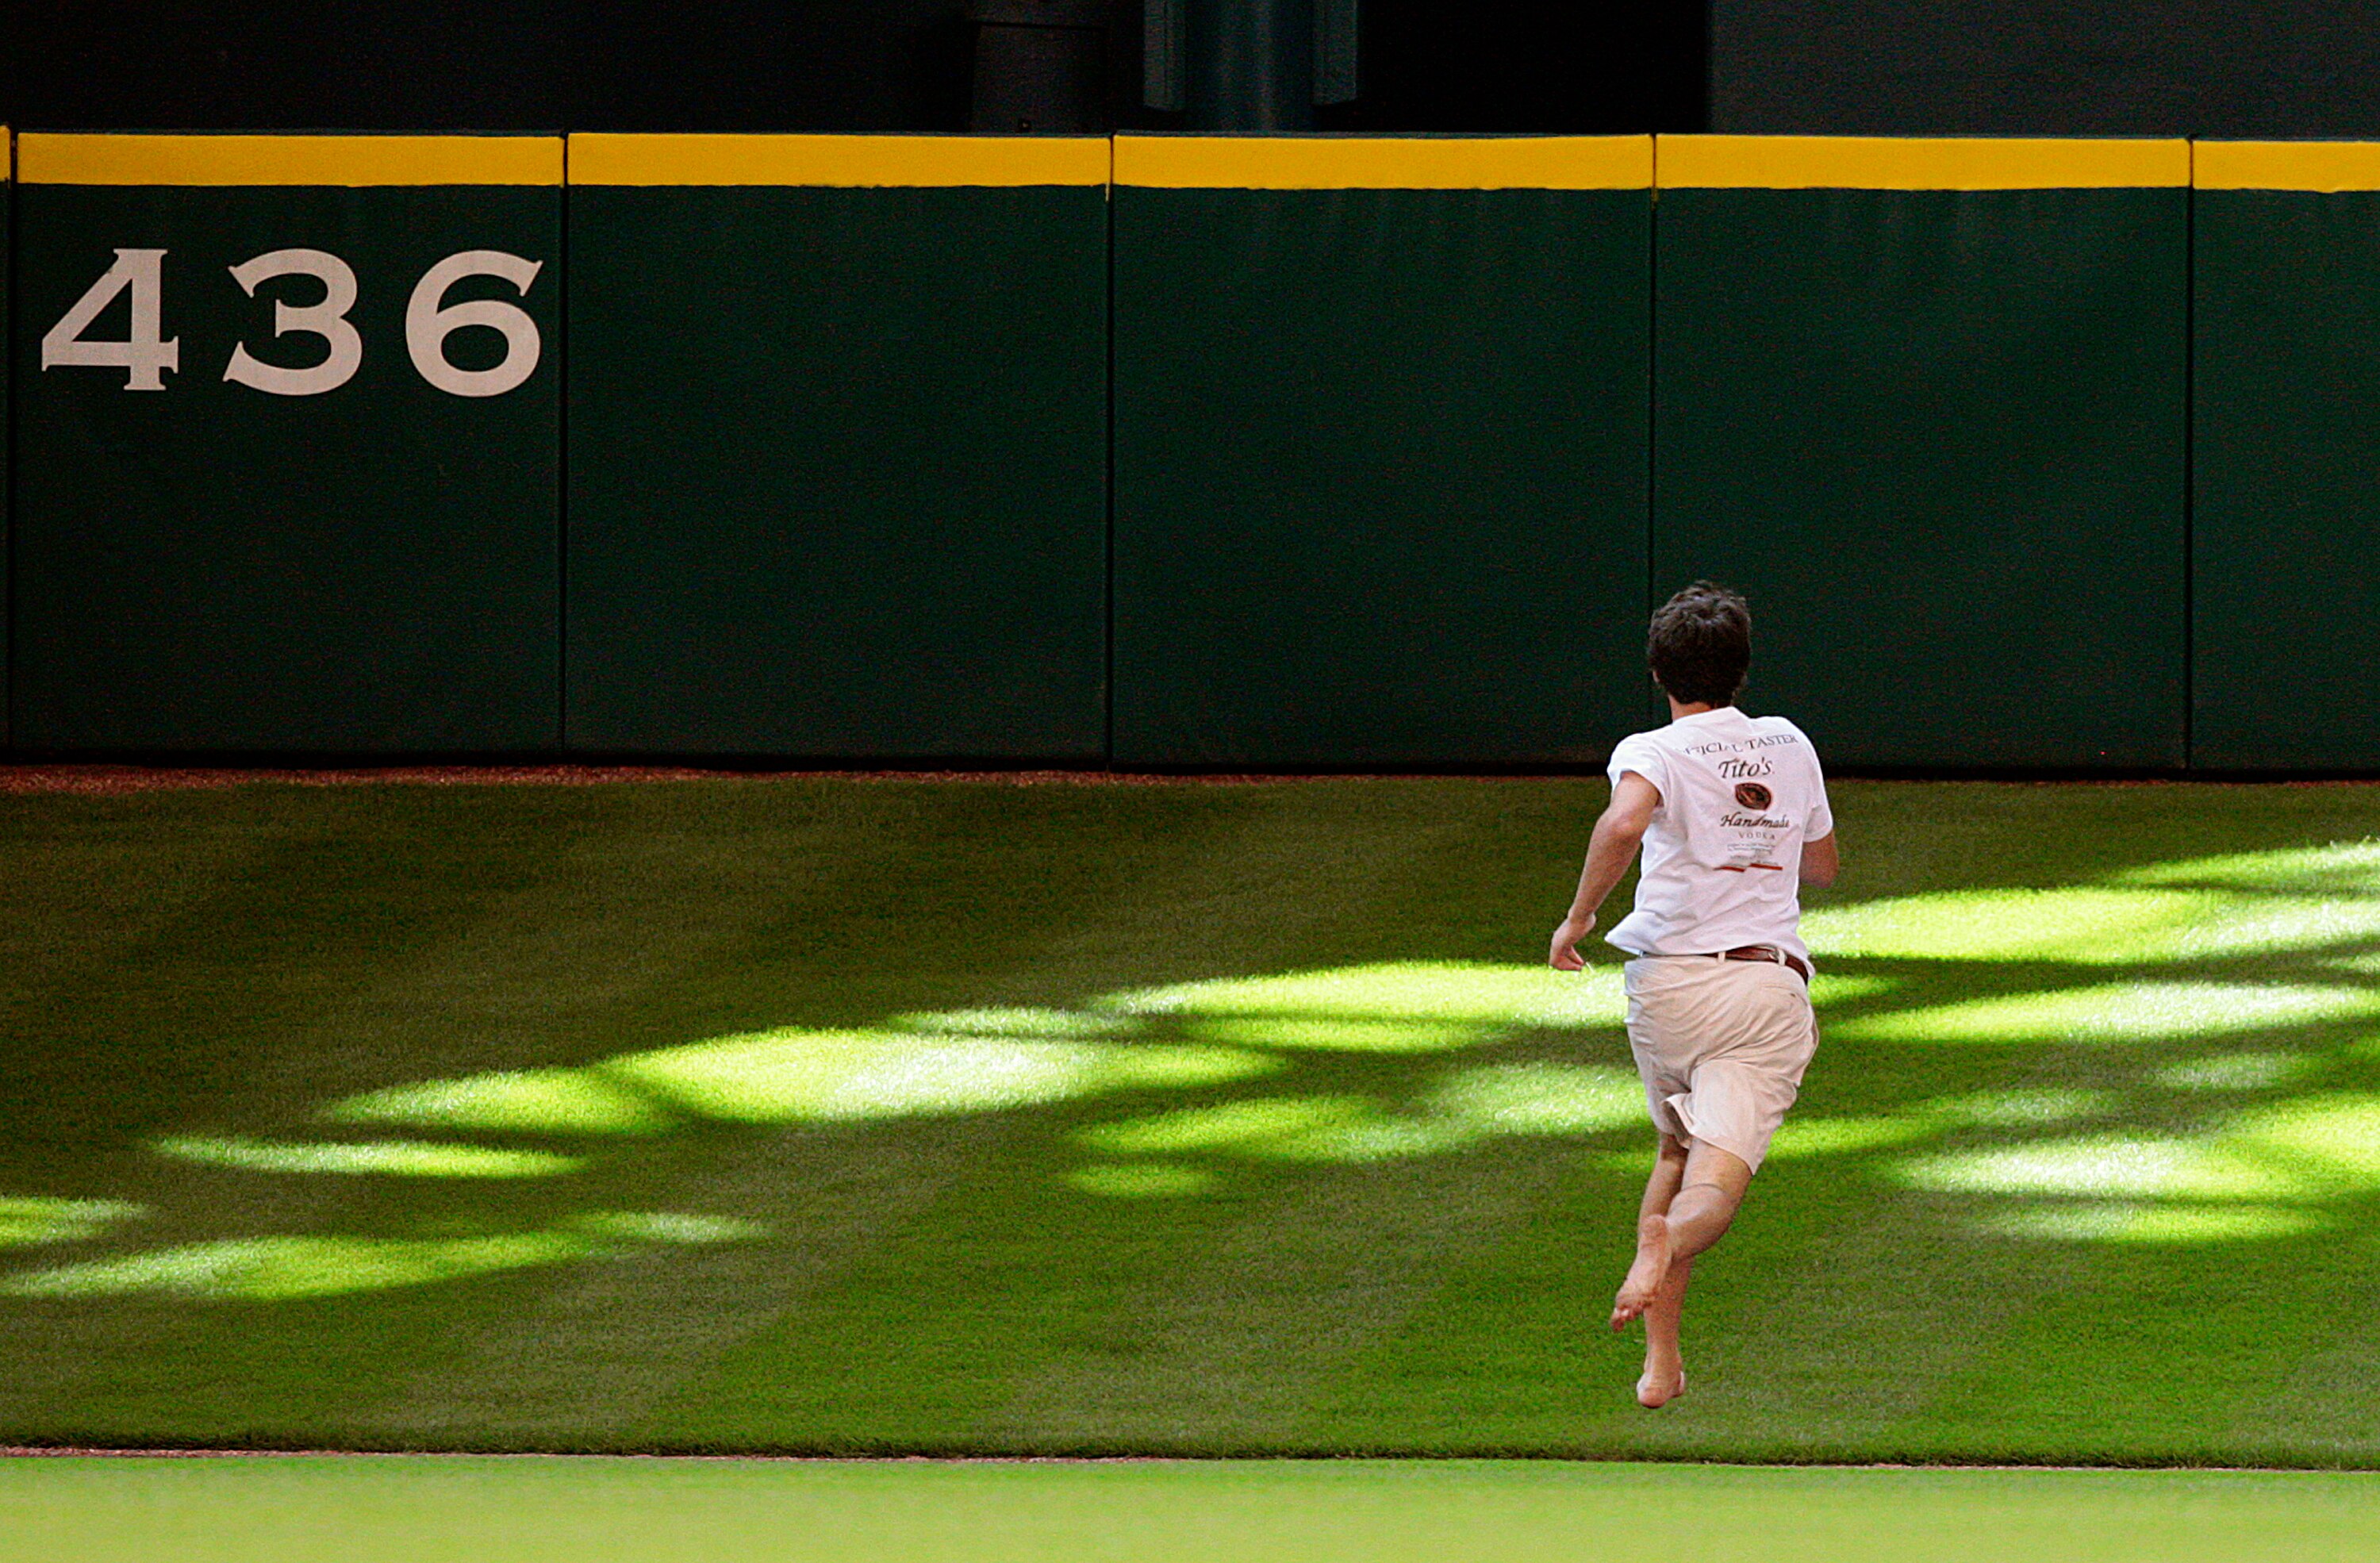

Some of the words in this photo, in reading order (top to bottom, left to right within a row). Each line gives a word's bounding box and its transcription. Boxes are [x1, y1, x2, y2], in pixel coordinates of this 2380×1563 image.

[41, 248, 544, 397] 436
[1681, 742, 1744, 755] ICIAL
[1745, 734, 1798, 750] TASTER
[1718, 757, 1772, 778] Tito's
[1720, 811, 1790, 828] Handmade
